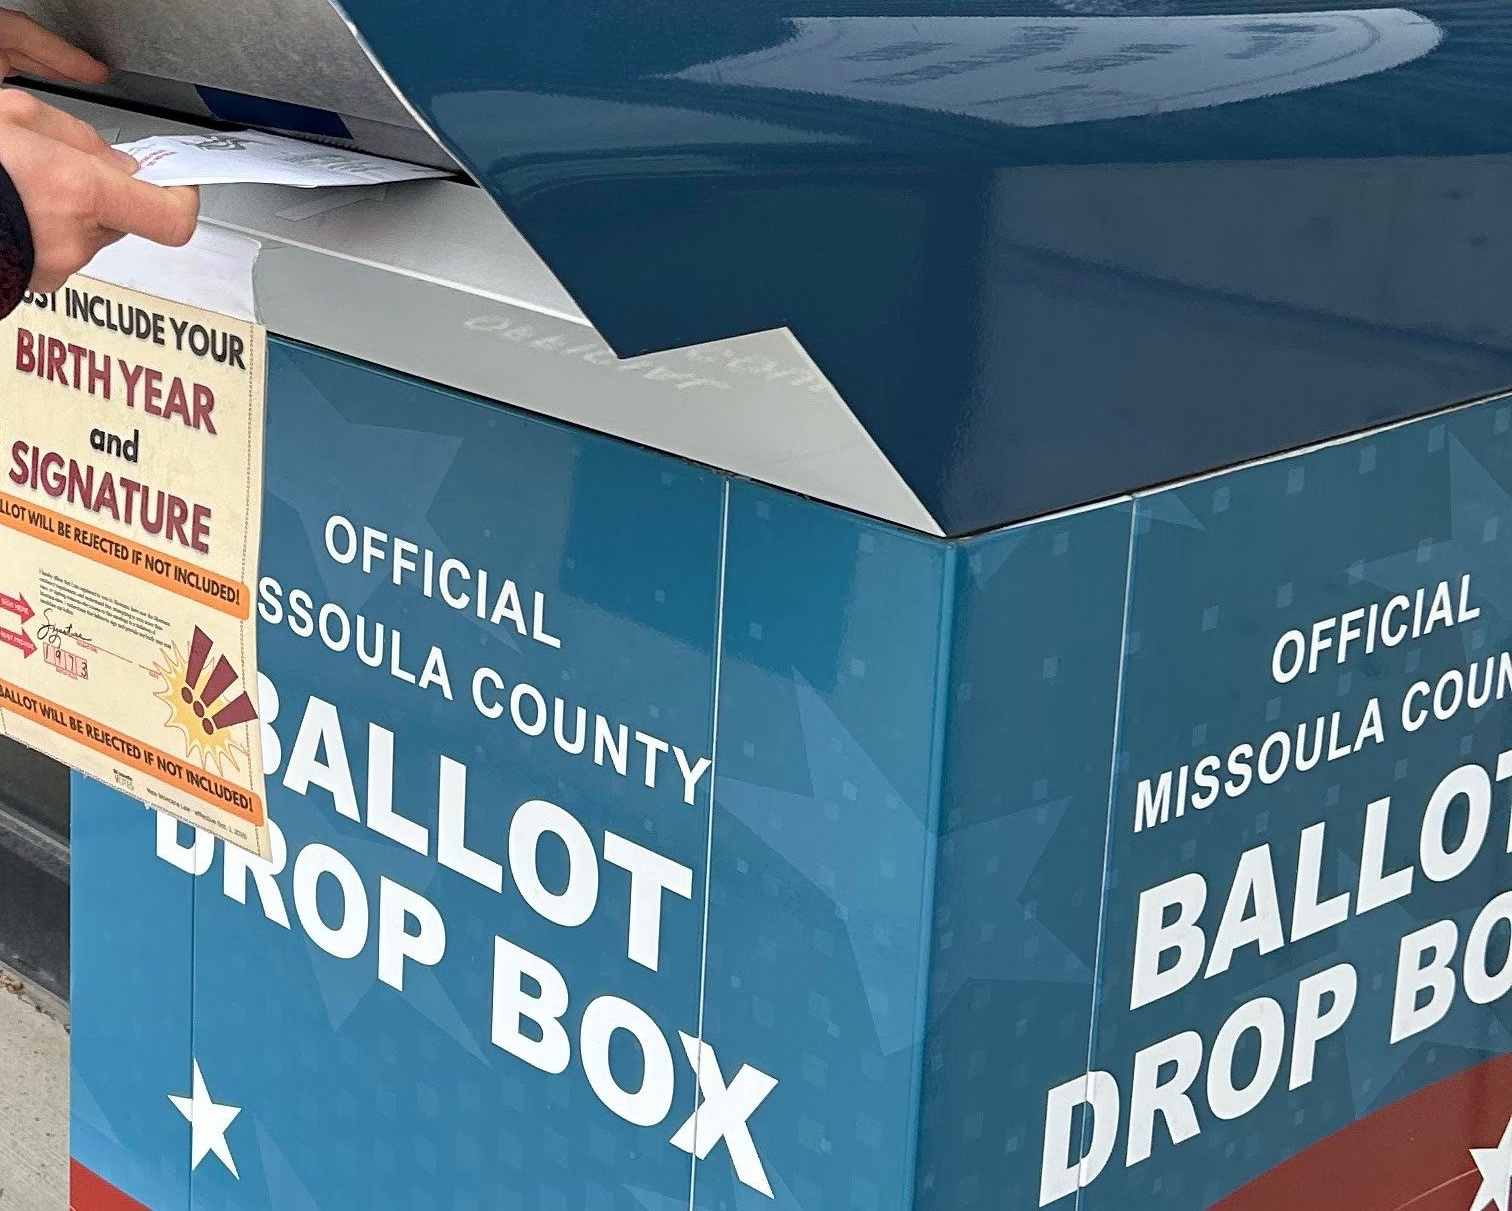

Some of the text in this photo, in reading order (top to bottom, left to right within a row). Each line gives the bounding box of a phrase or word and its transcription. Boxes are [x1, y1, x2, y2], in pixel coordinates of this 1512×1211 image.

[16, 328, 217, 435] BIRTH YEAR
[64, 287, 165, 346] INCLUDE
[169, 317, 246, 370] YOUR
[9, 440, 212, 554] SIGNATURE
[89, 428, 139, 464] and
[28, 509, 55, 534] WILL
[57, 520, 72, 539] BE
[74, 527, 129, 561] REJECTED
[131, 547, 143, 566] IF
[144, 553, 172, 579] NOT
[174, 565, 241, 606] INCLUDED!
[324, 515, 563, 649] OFFICIAL
[1271, 574, 1480, 684] OFFICIAL
[257, 576, 454, 701] SSOULA
[471, 668, 712, 806] COUNTY
[39, 704, 68, 728] WILL
[69, 715, 84, 734] BE
[86, 722, 141, 760] REJECTED
[144, 750, 155, 766] IF
[156, 755, 185, 780] NOT
[186, 768, 254, 813] INCLUDED!
[1133, 697, 1384, 833] MISSOULA
[491, 934, 779, 1200] BOX
[1038, 963, 1357, 1208] DROP
